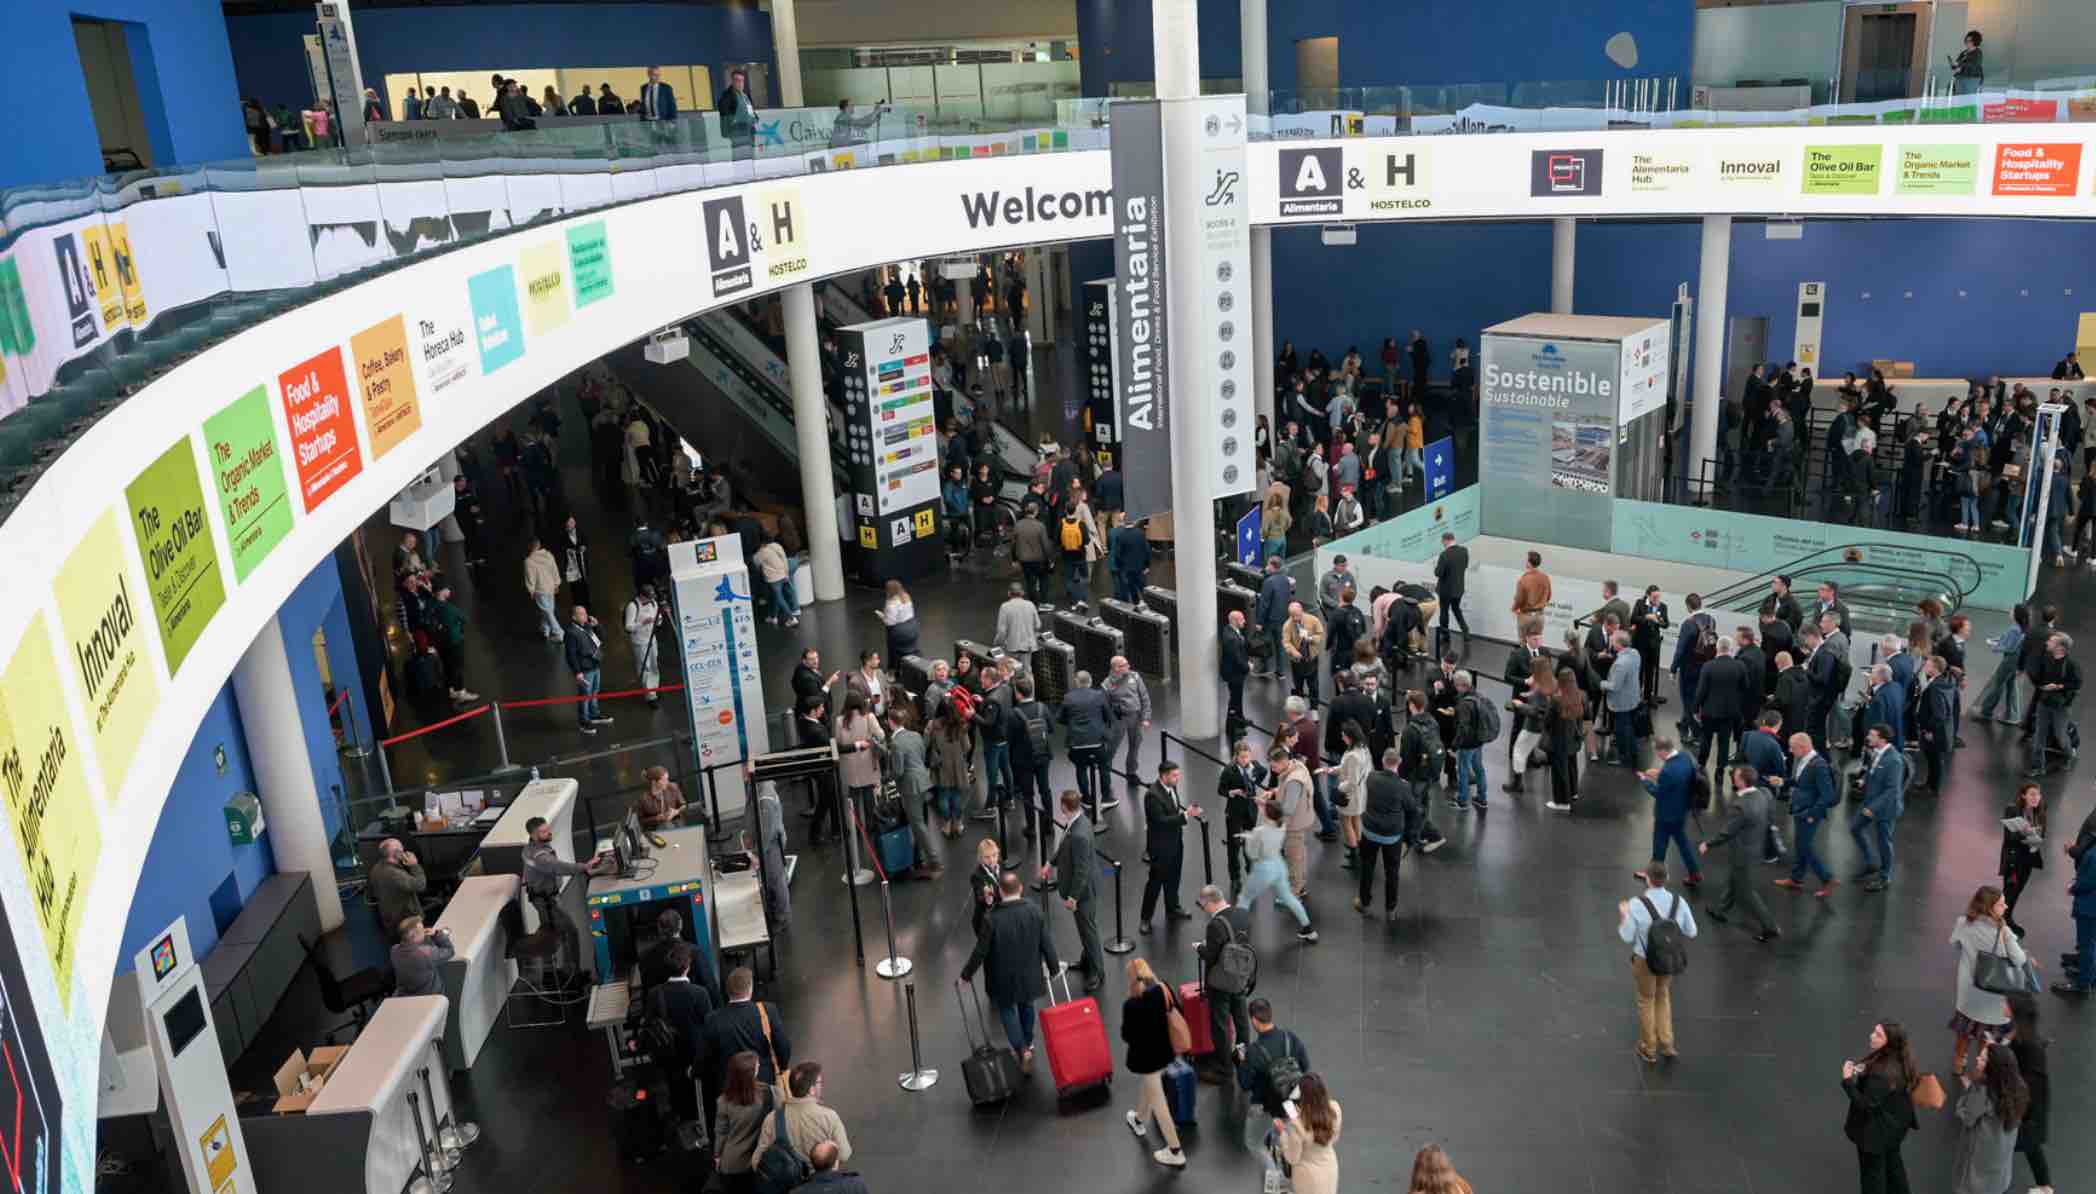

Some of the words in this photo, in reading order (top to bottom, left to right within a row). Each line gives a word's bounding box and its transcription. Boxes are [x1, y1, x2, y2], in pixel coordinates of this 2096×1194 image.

[1632, 155, 1652, 164] The
[1811, 152, 1832, 160] The
[1904, 151, 1922, 160] The
[2001, 159, 2064, 170] Hospitality
[2003, 147, 2032, 157] Food
[2035, 148, 2044, 157] &
[1295, 155, 1327, 191] A
[1348, 167, 1365, 189] &
[1386, 154, 1415, 186] H
[1632, 165, 1689, 174] Alimentaria
[1721, 160, 1780, 174] Innoval
[1811, 162, 1838, 171] Olive
[1839, 162, 1854, 171] Oil
[1856, 162, 1875, 171] Bar
[1904, 161, 1937, 171] Organic
[1938, 160, 1971, 169] Market
[2000, 171, 2049, 181] Startups
[1632, 175, 1653, 184] Hub
[961, 187, 1113, 229] Welcom
[1283, 202, 1338, 214] Alimentaria
[1370, 199, 1431, 210] HOSTELCO
[719, 209, 739, 259] A
[750, 222, 763, 252] &
[772, 201, 794, 244] H
[769, 258, 808, 277] HOSTELCO
[1122, 197, 1152, 430] Alimentaria
[419, 320, 435, 338] The
[423, 337, 450, 362] Horeca
[449, 328, 465, 352] Hub
[286, 379, 309, 407] Food
[310, 370, 321, 394] &
[1484, 364, 1611, 397] Sostenible
[366, 385, 373, 403] &
[1485, 388, 1570, 409] Sustainable
[292, 393, 340, 437] Hospitality
[214, 440, 232, 465] The
[298, 429, 337, 467] Startups
[220, 457, 250, 495] Organic
[249, 439, 273, 472] Market
[229, 504, 236, 526] &
[234, 485, 260, 518] Trends
[138, 505, 161, 541] The
[148, 540, 175, 581] Olive
[171, 516, 186, 553] Oil
[184, 507, 205, 540] Bar
[76, 572, 134, 702] Innoval
[2, 746, 23, 808] The
[20, 724, 66, 872] Alimentaria
[35, 850, 55, 929] Hub
